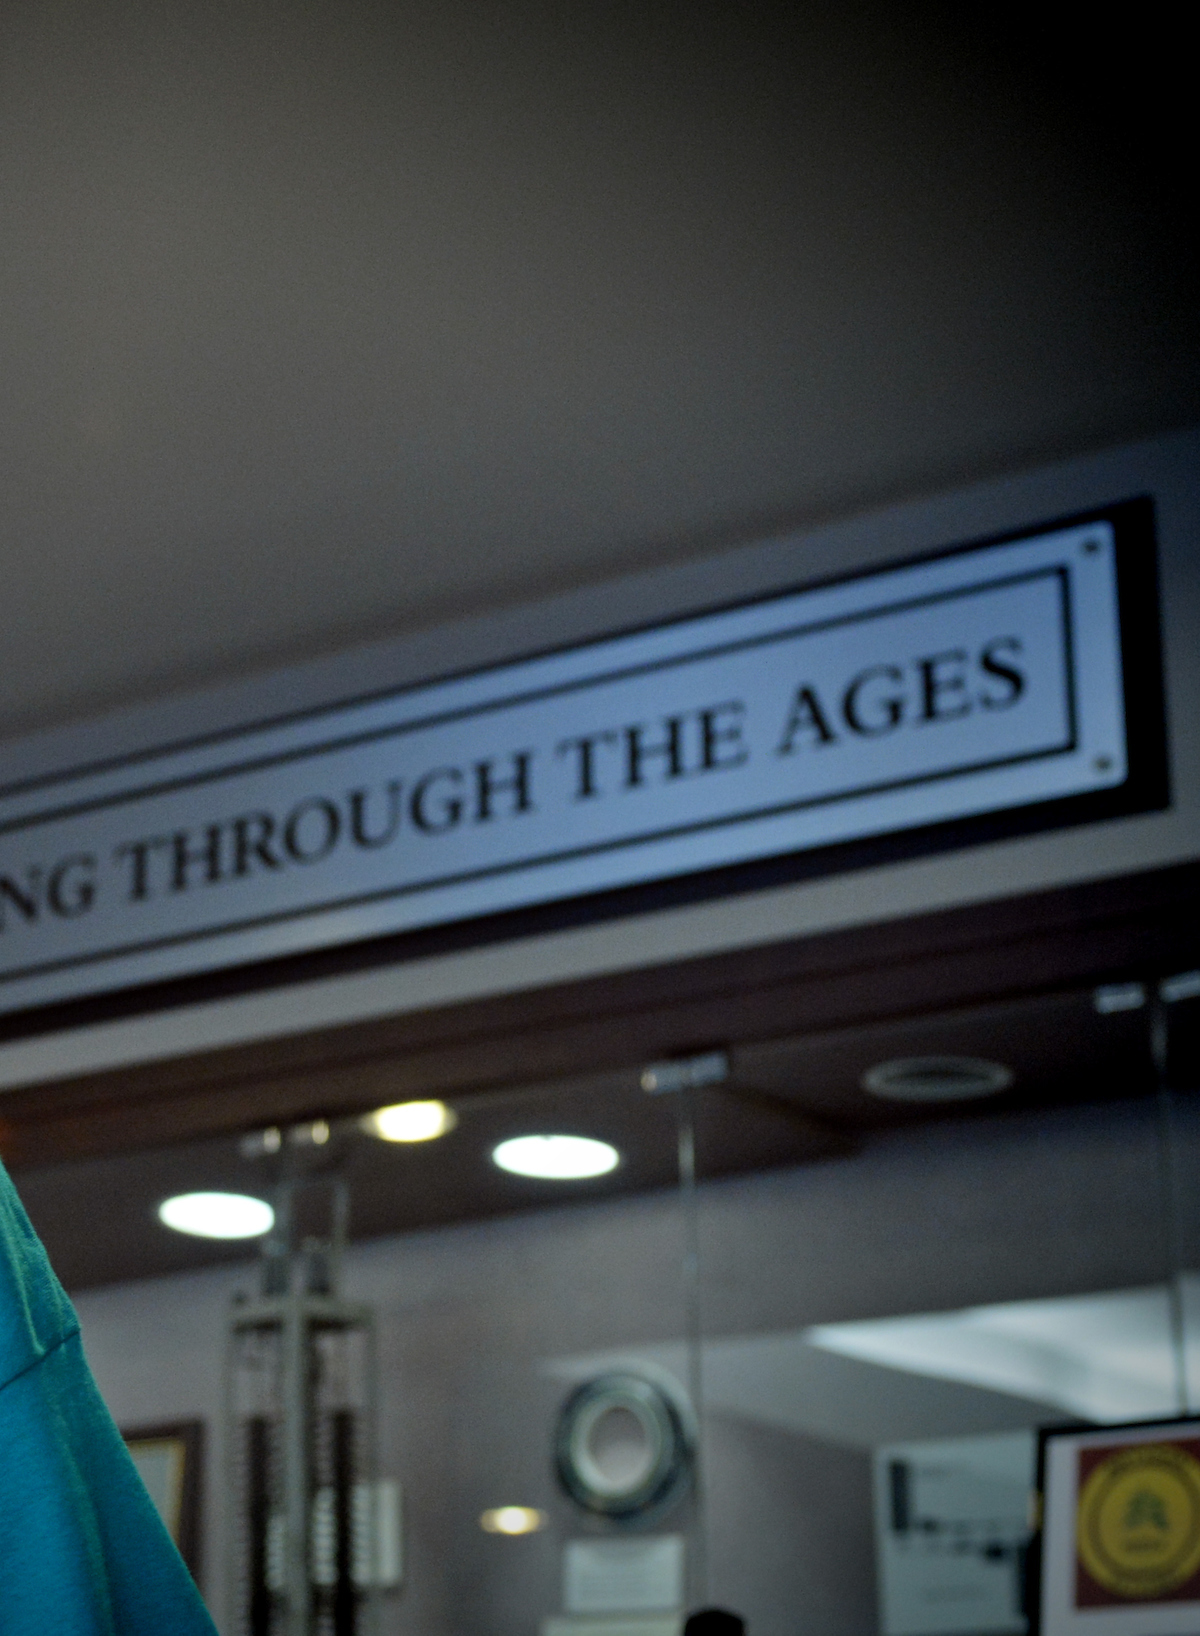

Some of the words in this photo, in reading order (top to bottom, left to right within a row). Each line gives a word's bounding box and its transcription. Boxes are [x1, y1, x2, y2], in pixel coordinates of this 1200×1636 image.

[111, 748, 537, 902] THROUGH
[554, 698, 749, 800] THE
[774, 636, 1028, 757] AGES
